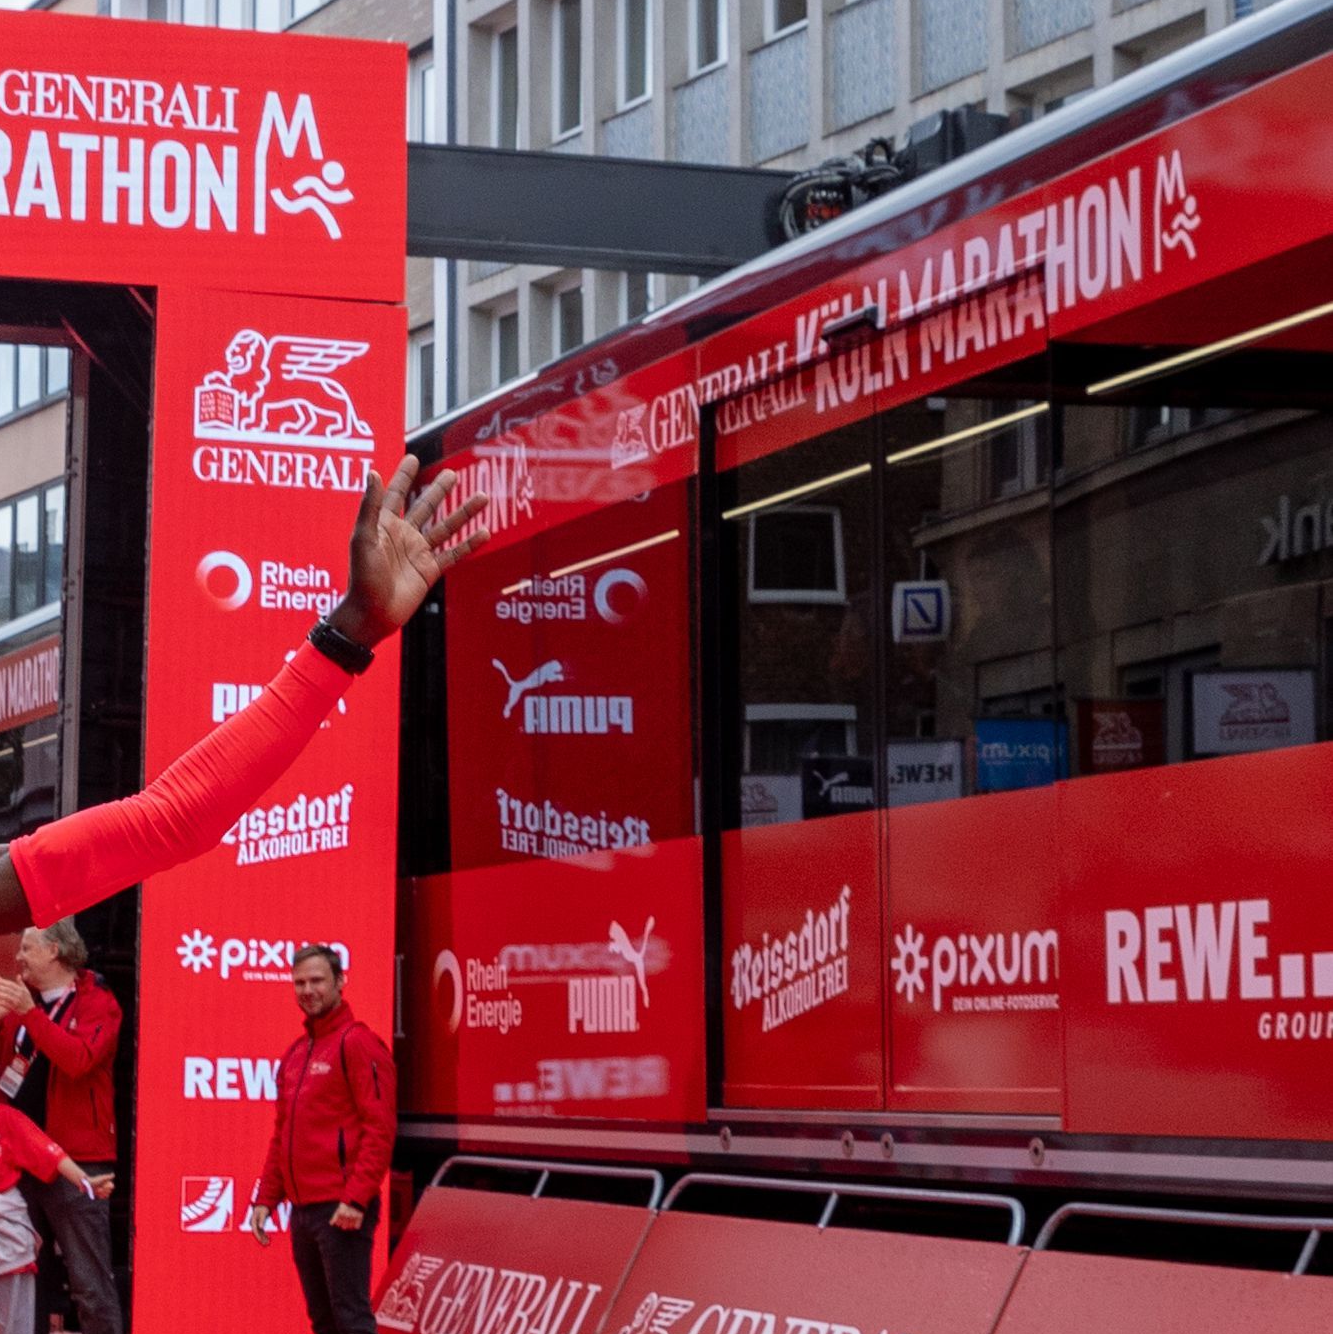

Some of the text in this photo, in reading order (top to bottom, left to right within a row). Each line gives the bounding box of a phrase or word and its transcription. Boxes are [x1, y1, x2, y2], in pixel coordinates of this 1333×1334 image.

[192, 445, 375, 493] GENERALI
[261, 560, 330, 588] Rhein
[235, 824, 350, 867] ALKOHOLFREI
[730, 883, 853, 1011] Reissdorf
[931, 929, 1059, 1012] pixum
[466, 958, 509, 992] Rhein
[762, 955, 849, 1033] ALKOHOLFREI
[466, 994, 523, 1035] Energie
[568, 975, 637, 1034] PUMA
